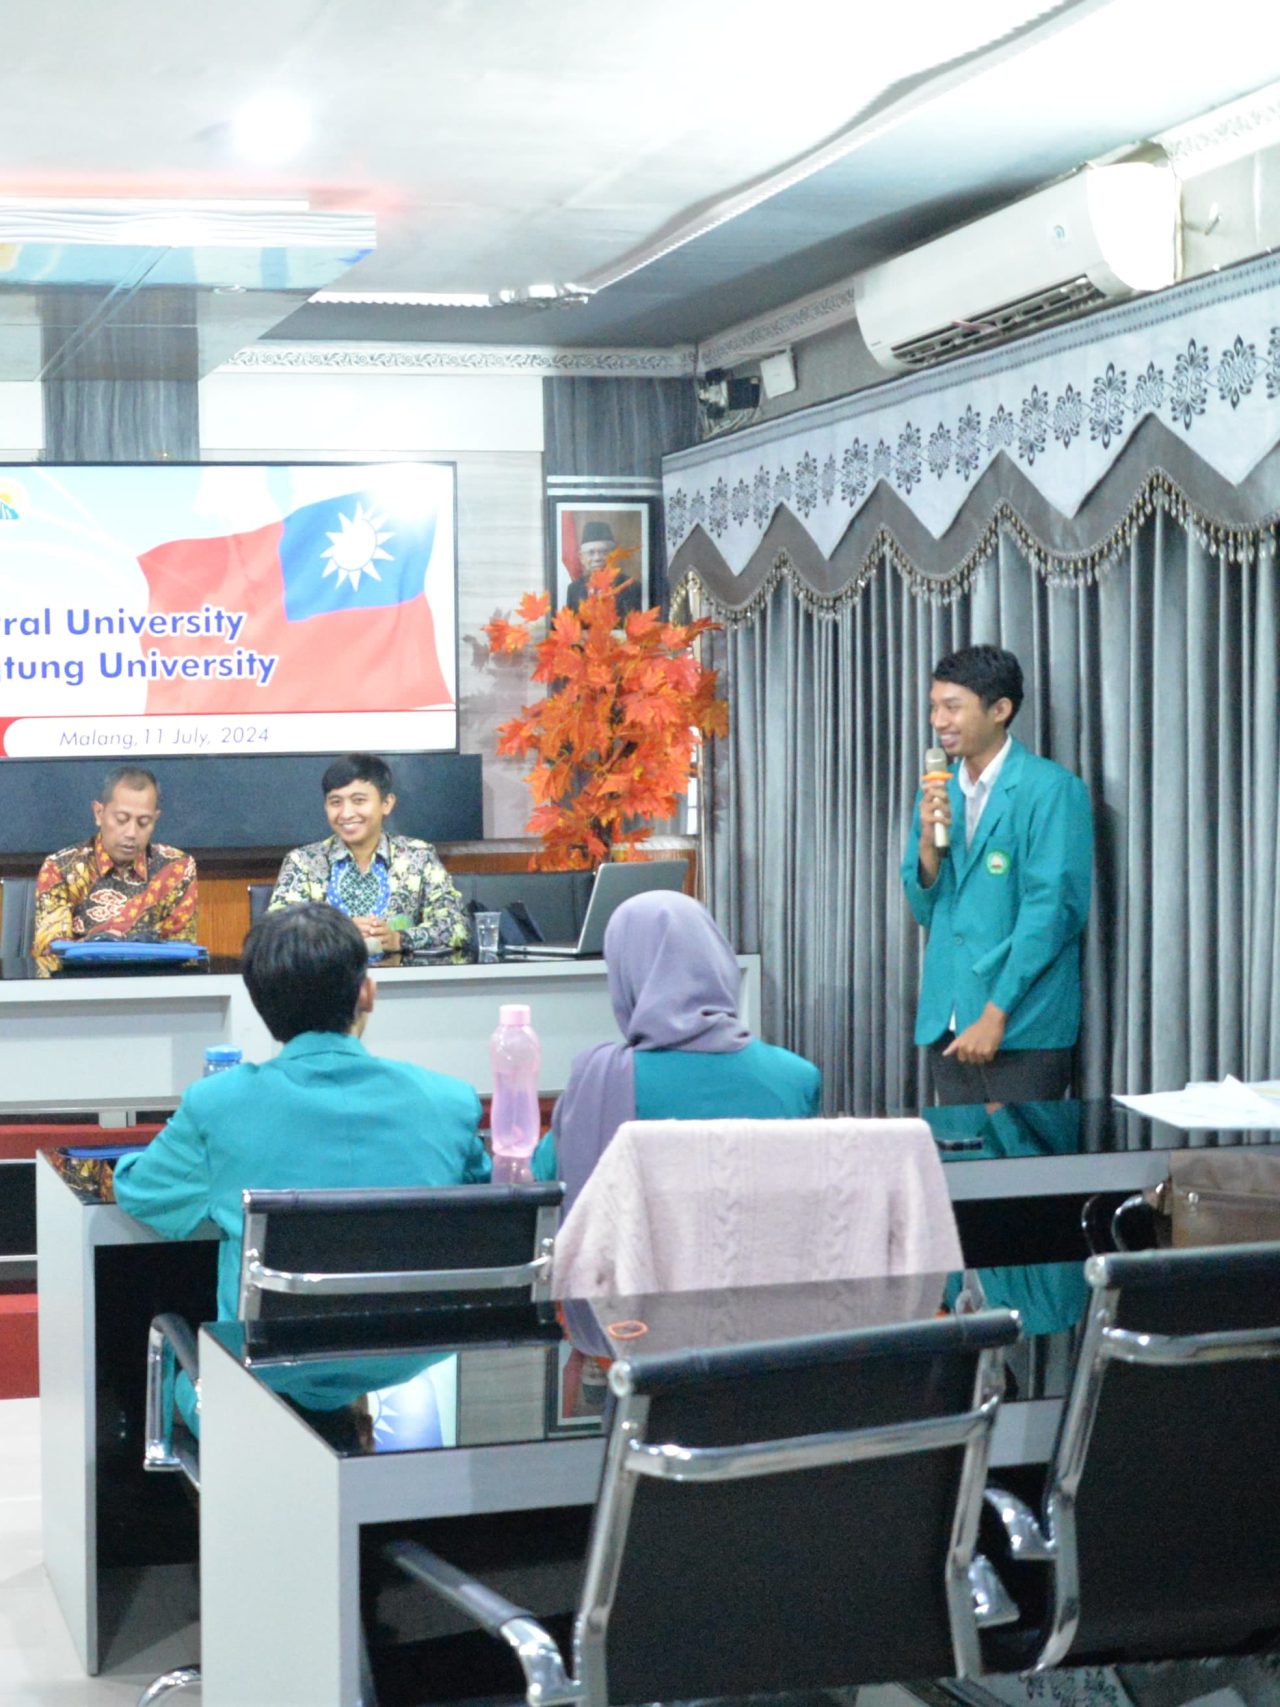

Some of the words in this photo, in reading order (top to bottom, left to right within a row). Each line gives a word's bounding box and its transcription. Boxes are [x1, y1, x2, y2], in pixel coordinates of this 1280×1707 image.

[66, 606, 244, 642] University
[99, 651, 277, 685] University
[59, 729, 138, 750] Malang,
[145, 728, 164, 745] 11
[172, 727, 210, 748] July,
[221, 726, 270, 744] 2024
